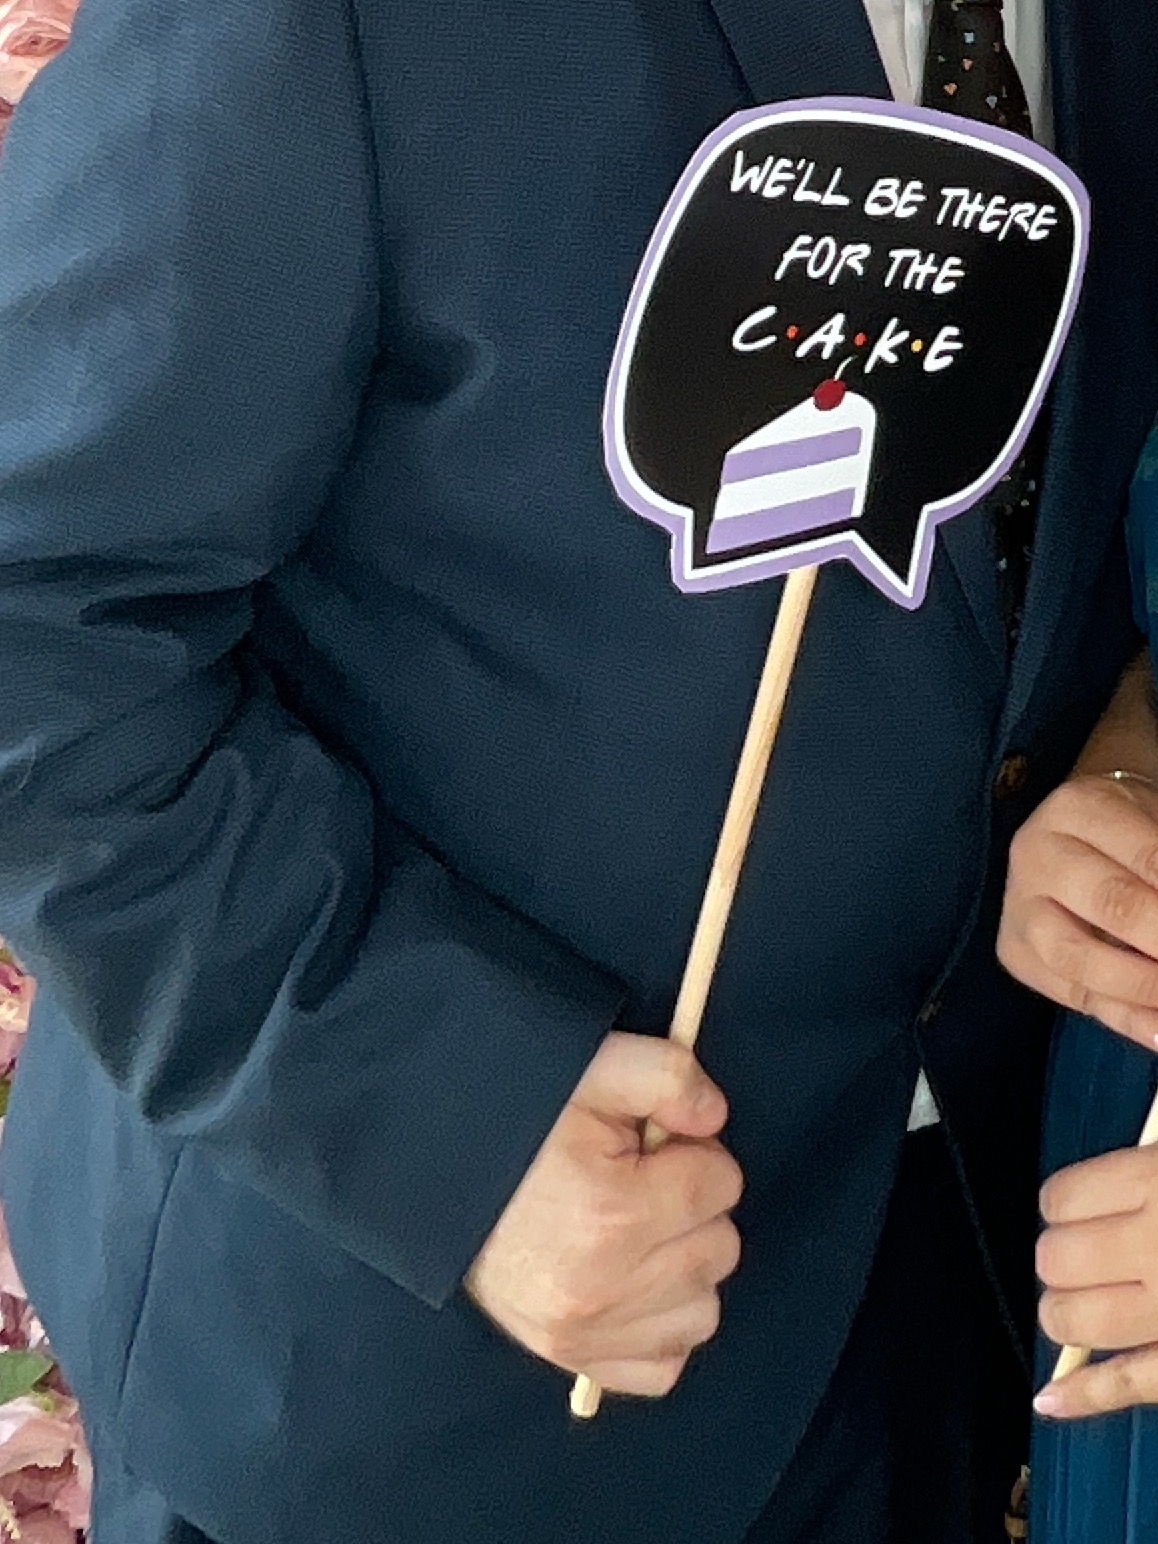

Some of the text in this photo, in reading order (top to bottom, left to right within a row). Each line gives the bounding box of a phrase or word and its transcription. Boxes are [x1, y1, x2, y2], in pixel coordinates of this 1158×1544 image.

[730, 150, 1058, 241] WE'LL BE THERE
[774, 234, 966, 294] FOR THE
